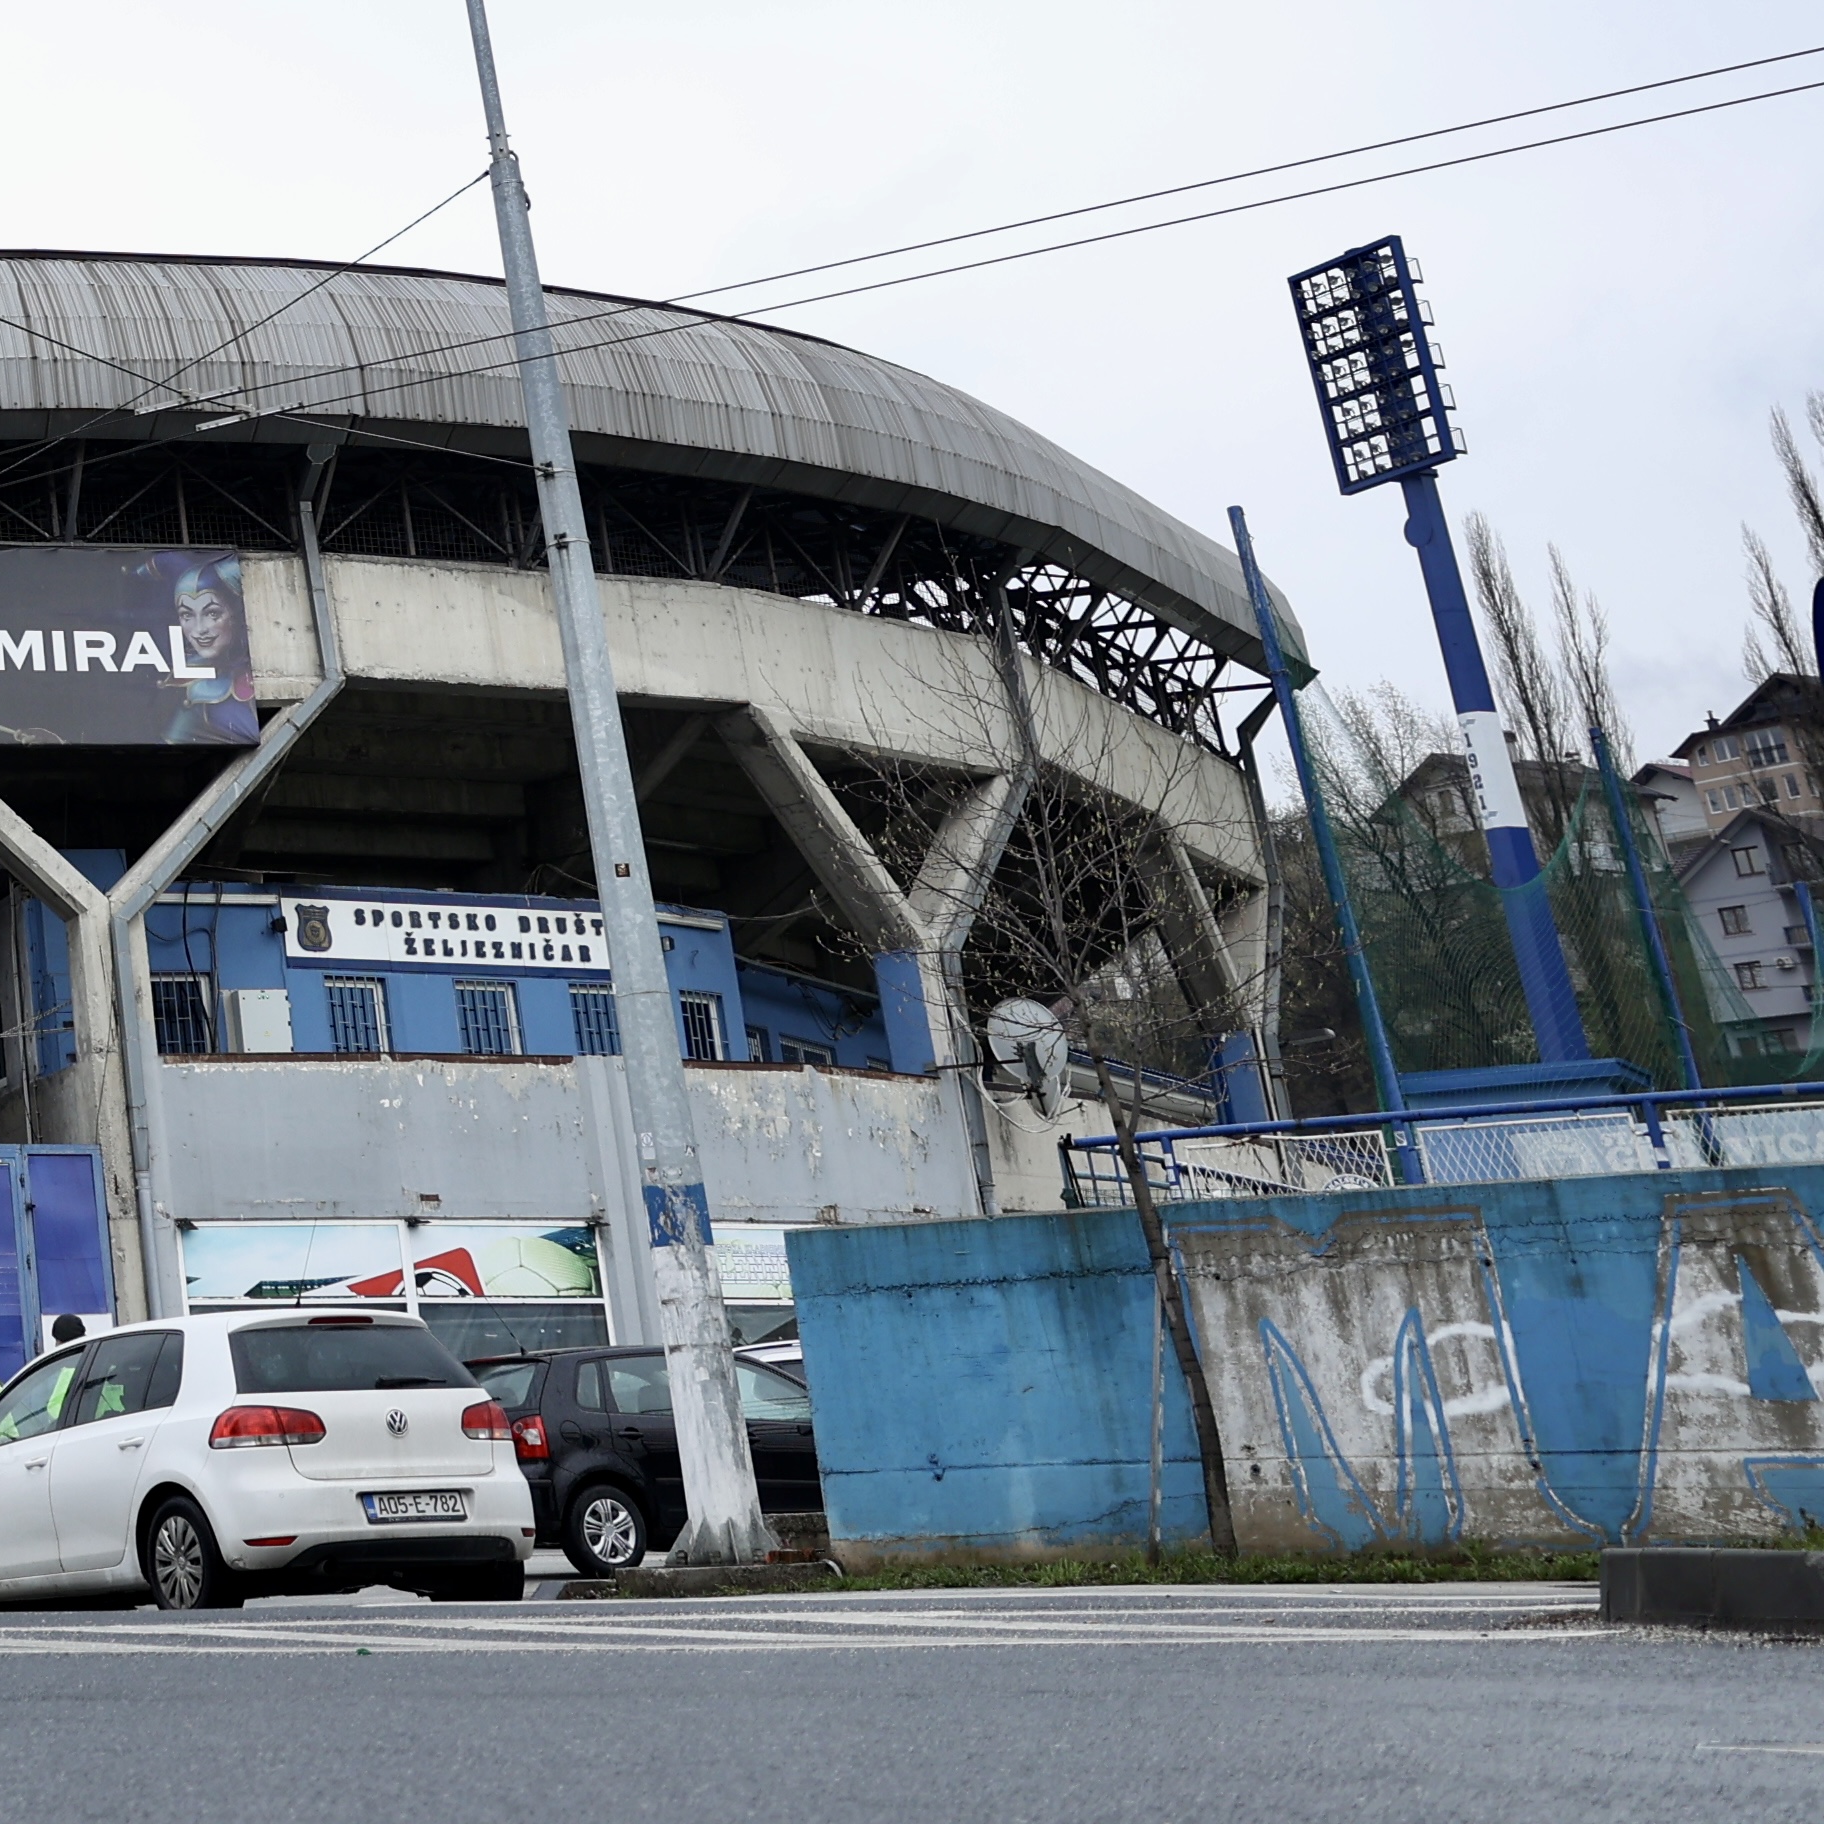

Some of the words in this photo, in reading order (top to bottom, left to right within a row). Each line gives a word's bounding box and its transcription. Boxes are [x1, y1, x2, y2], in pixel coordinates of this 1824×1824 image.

[1463, 732, 1488, 811] 1921
[353, 908, 497, 932] SPORTSKO
[404, 931, 592, 963] ŽELJEZNIČAR
[378, 1494, 461, 1515] A05-E-782
